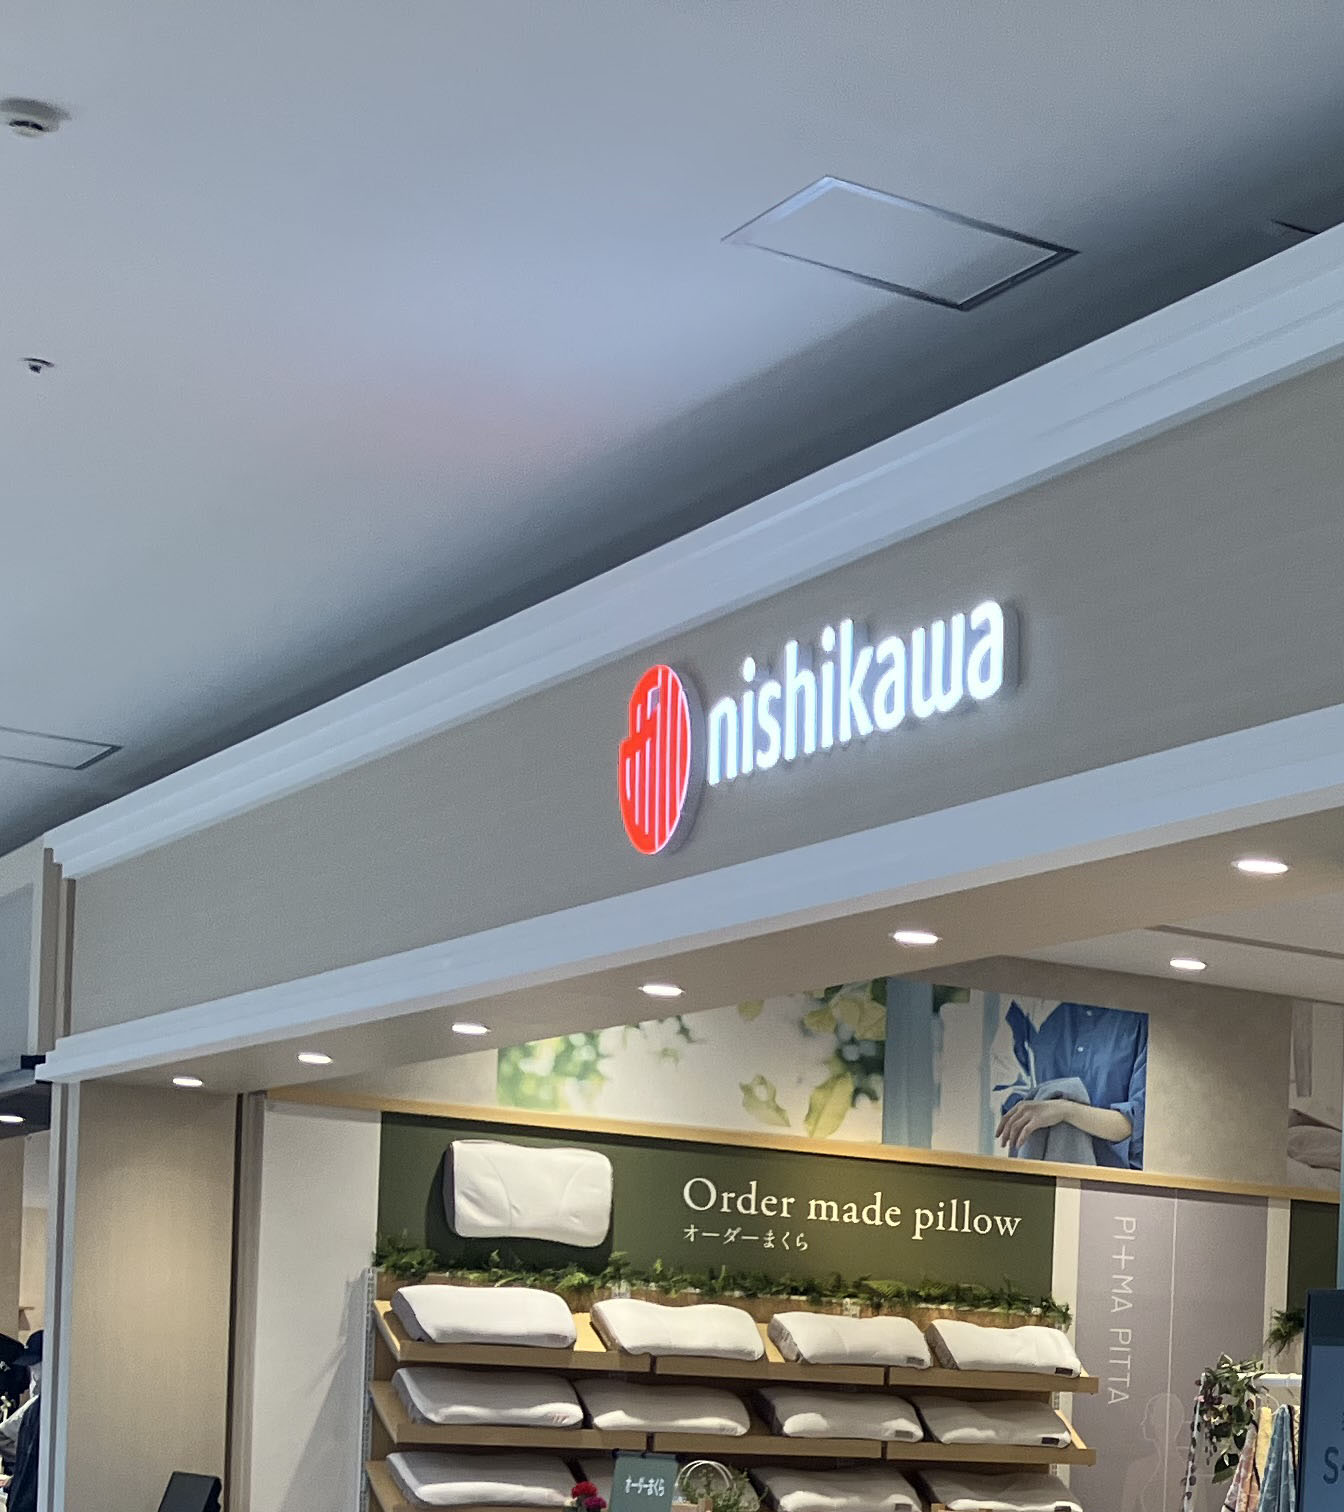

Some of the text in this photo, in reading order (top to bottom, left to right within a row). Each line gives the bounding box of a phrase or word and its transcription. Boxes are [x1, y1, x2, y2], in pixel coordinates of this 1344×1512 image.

[707, 599, 1005, 787] nishikawa
[683, 1177, 1022, 1240] Order made pillow
[683, 1224, 808, 1251] オーダーまくら
[1107, 1328, 1132, 1405] PITTA
